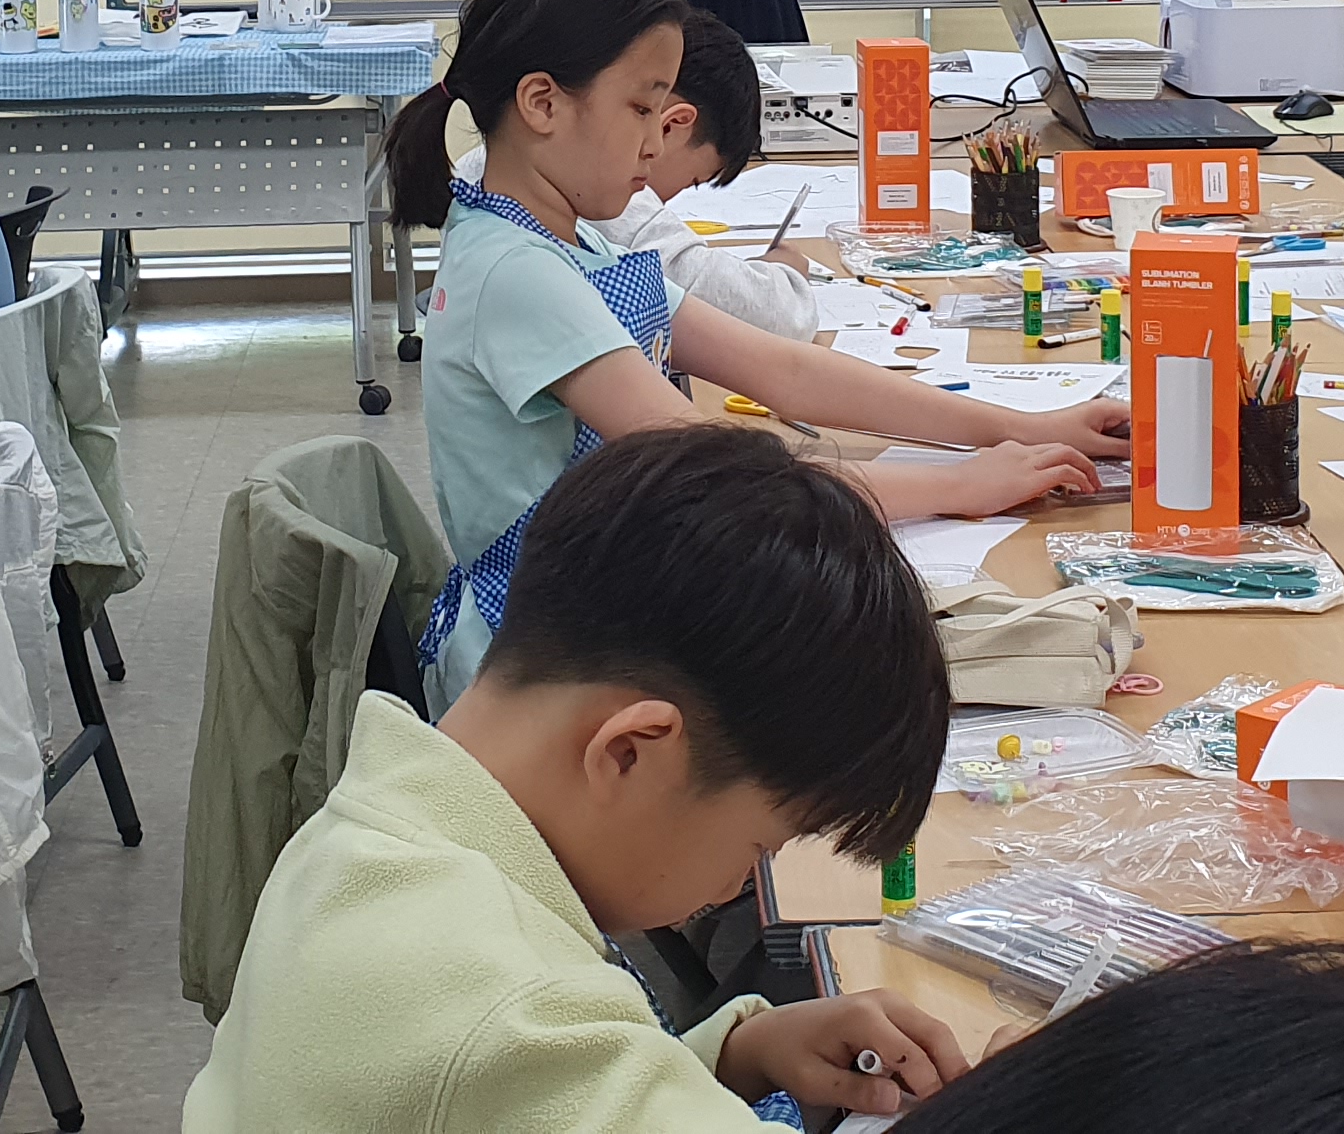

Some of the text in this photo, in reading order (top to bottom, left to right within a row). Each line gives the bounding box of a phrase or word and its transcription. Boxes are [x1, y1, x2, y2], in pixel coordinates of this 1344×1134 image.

[1141, 270, 1200, 278] SUBLIMATION
[1141, 280, 1213, 289] BLANK TUMBLER
